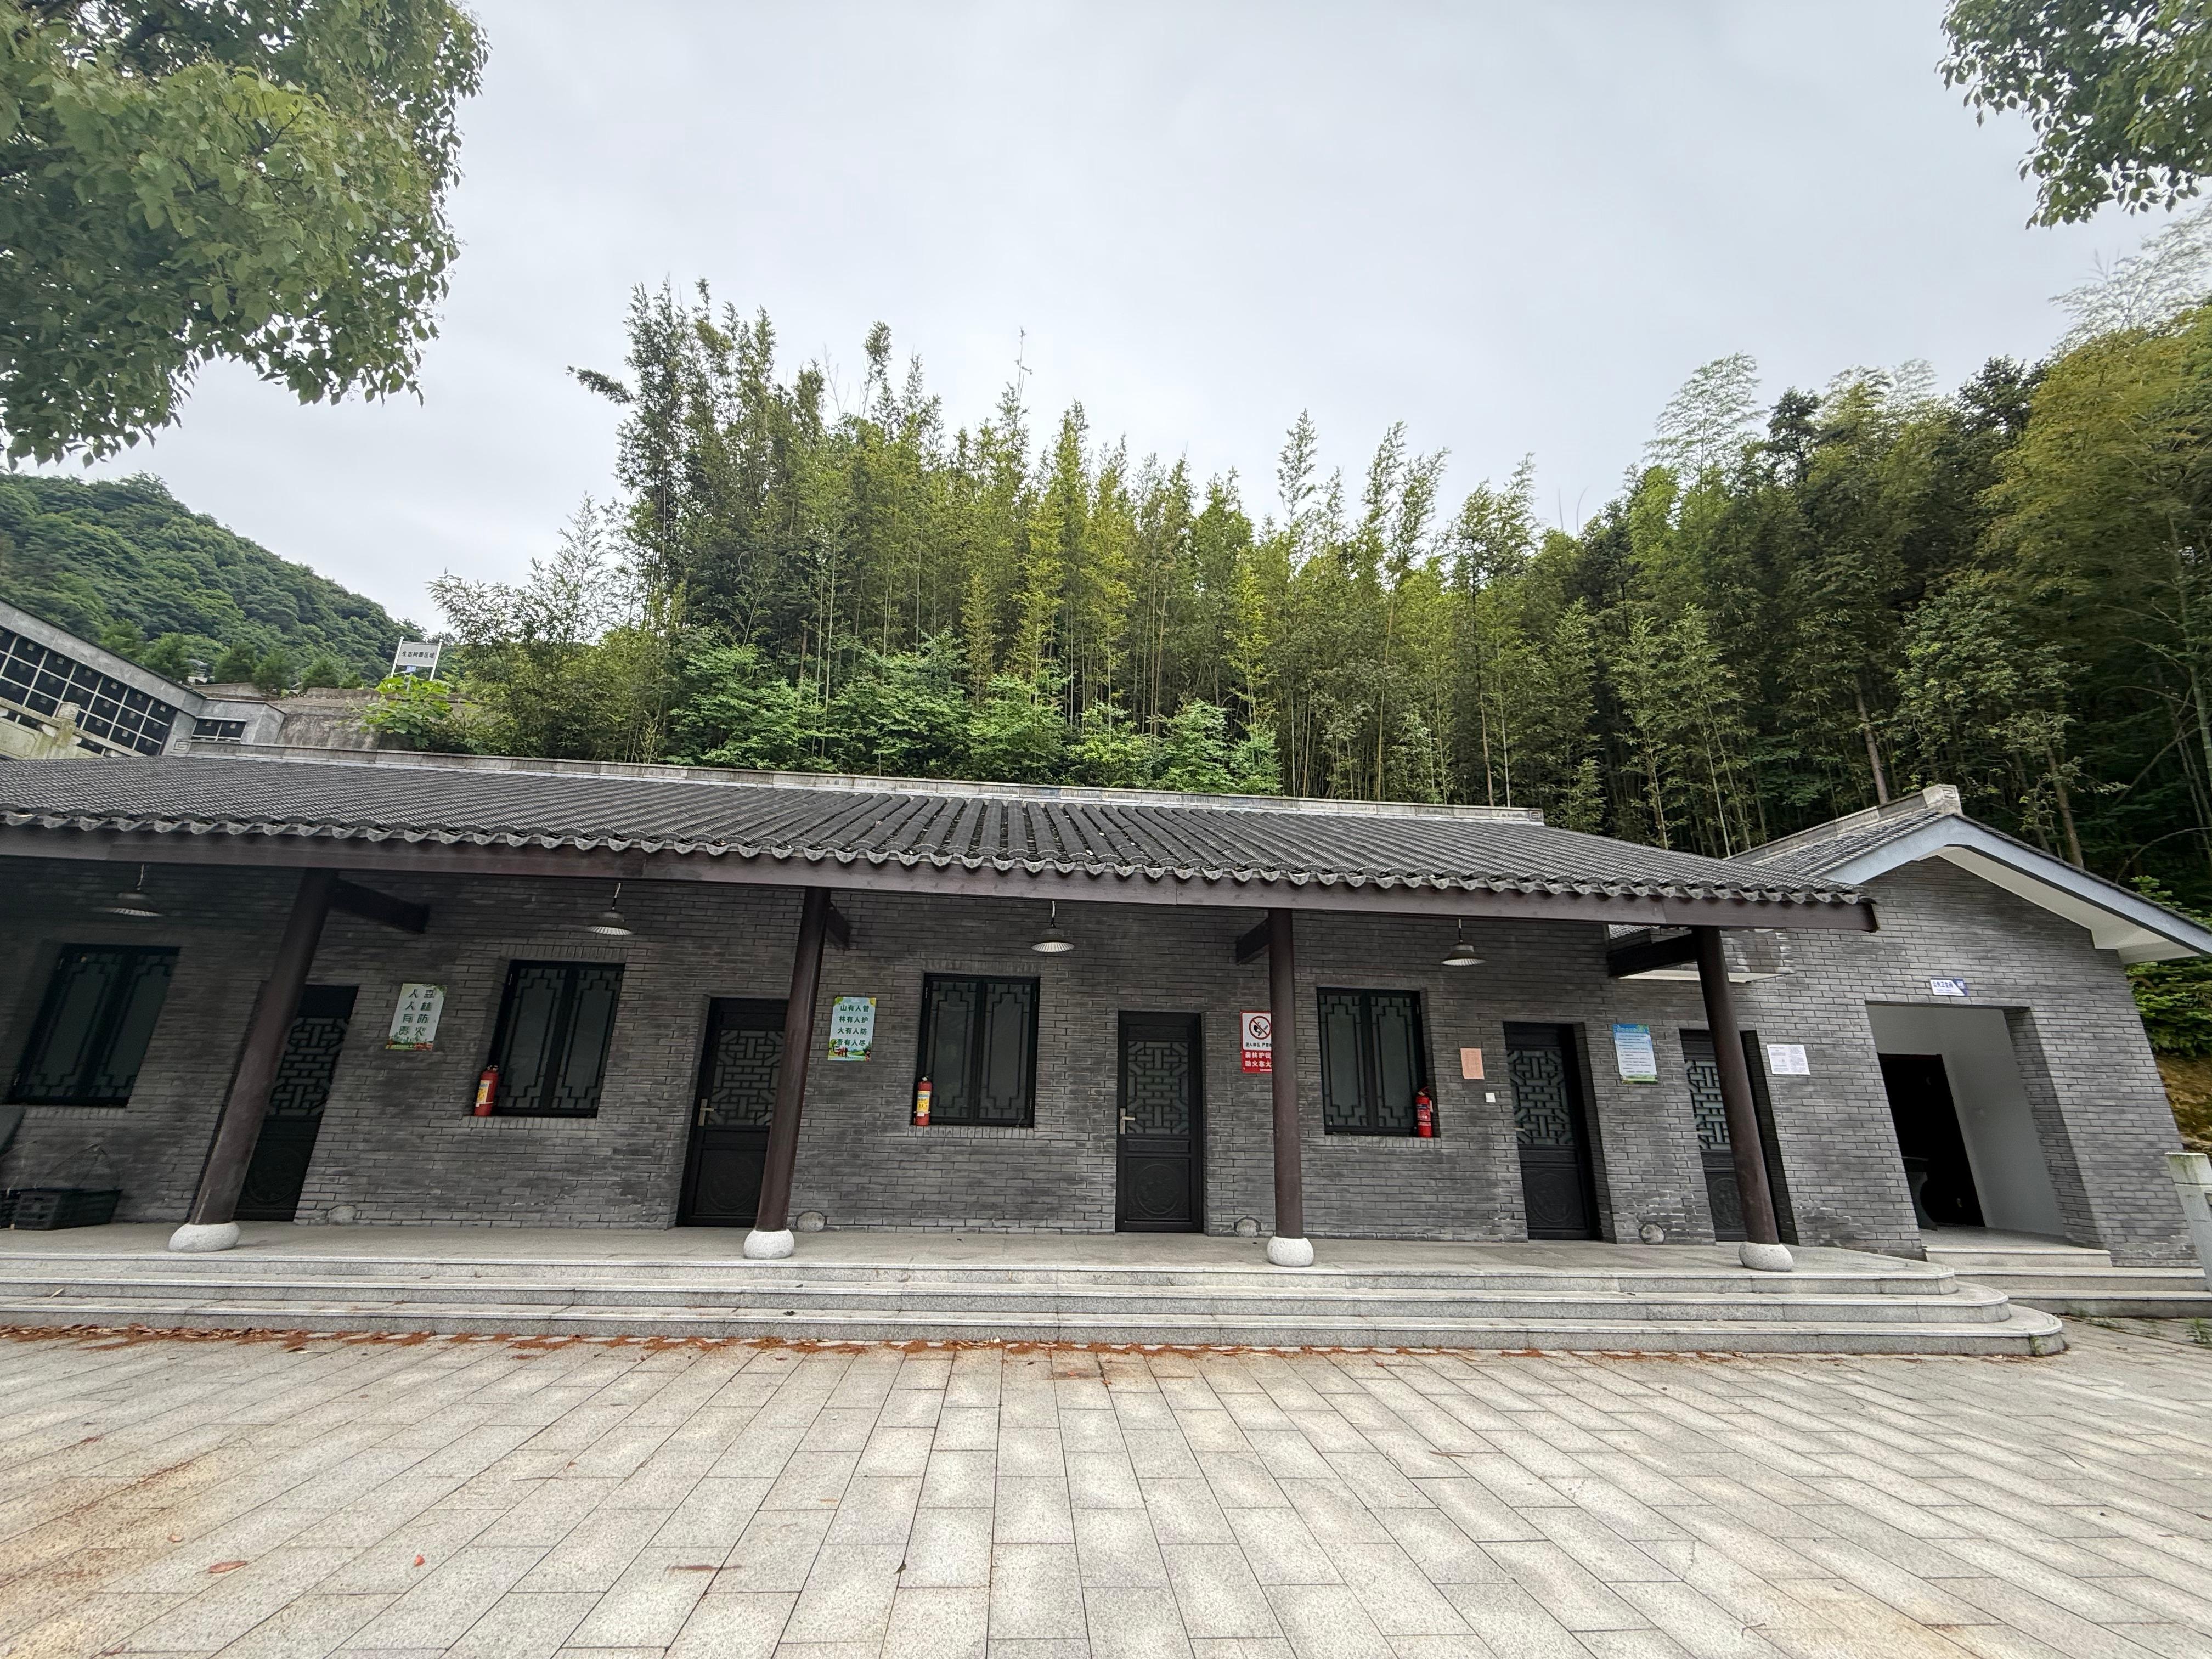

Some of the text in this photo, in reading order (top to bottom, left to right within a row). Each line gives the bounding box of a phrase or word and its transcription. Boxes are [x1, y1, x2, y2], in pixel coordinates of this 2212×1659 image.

[399, 989, 417, 1035] 人人有责
[414, 990, 435, 1036] 森林防火
